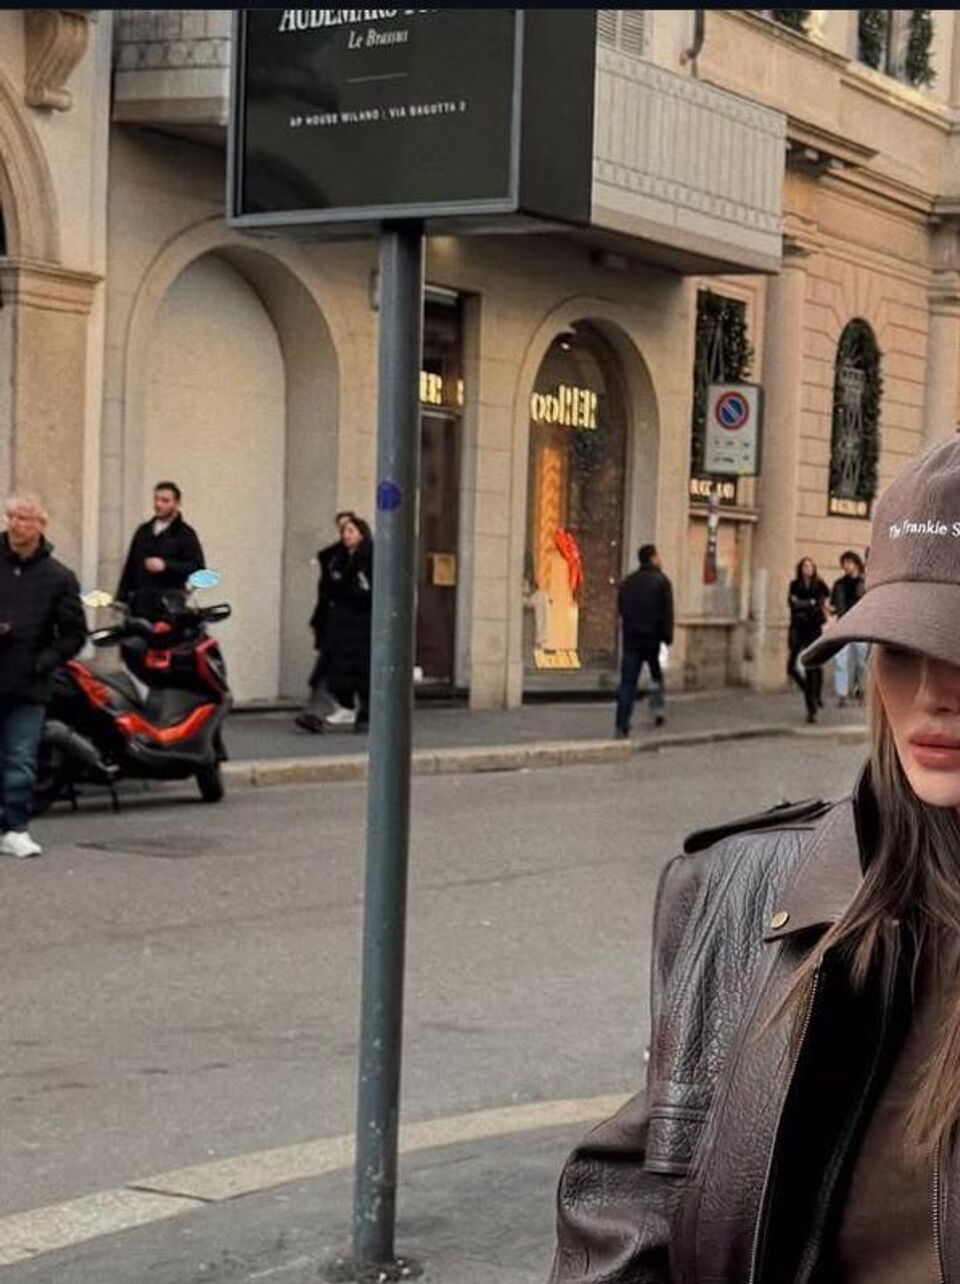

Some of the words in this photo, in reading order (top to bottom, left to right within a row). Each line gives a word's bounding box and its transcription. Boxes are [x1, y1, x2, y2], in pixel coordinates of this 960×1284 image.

[348, 30, 363, 49] Le
[341, 108, 379, 123] MILANO
[389, 106, 406, 118] VIA
